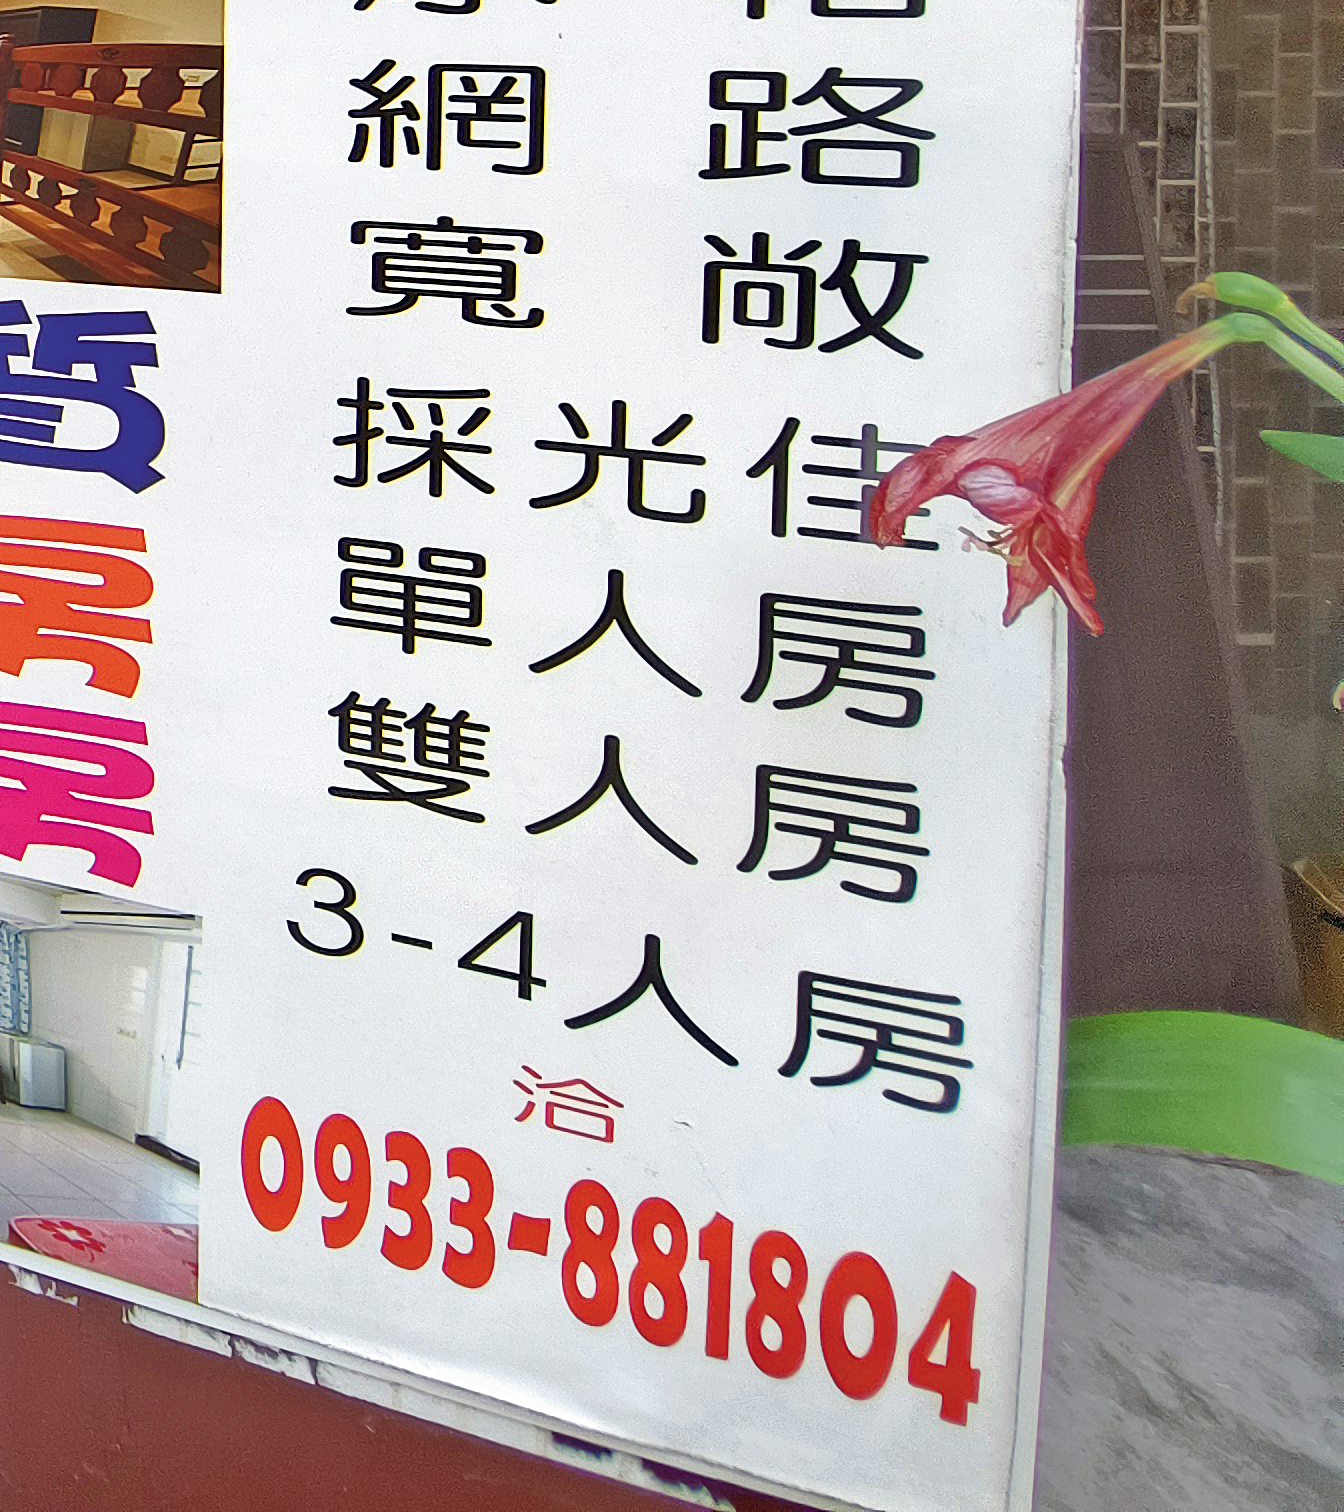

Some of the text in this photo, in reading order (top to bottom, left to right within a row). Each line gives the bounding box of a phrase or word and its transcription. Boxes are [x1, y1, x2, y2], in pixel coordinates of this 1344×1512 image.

[346, 57, 936, 188] 網路
[332, 376, 940, 551] 採光佳
[328, 535, 938, 731] 單人房
[325, 688, 931, 905] 雙人房
[286, 866, 974, 1115] 3-4人房
[514, 1062, 625, 1144] 洽
[239, 1094, 982, 1425] 0933-881804
